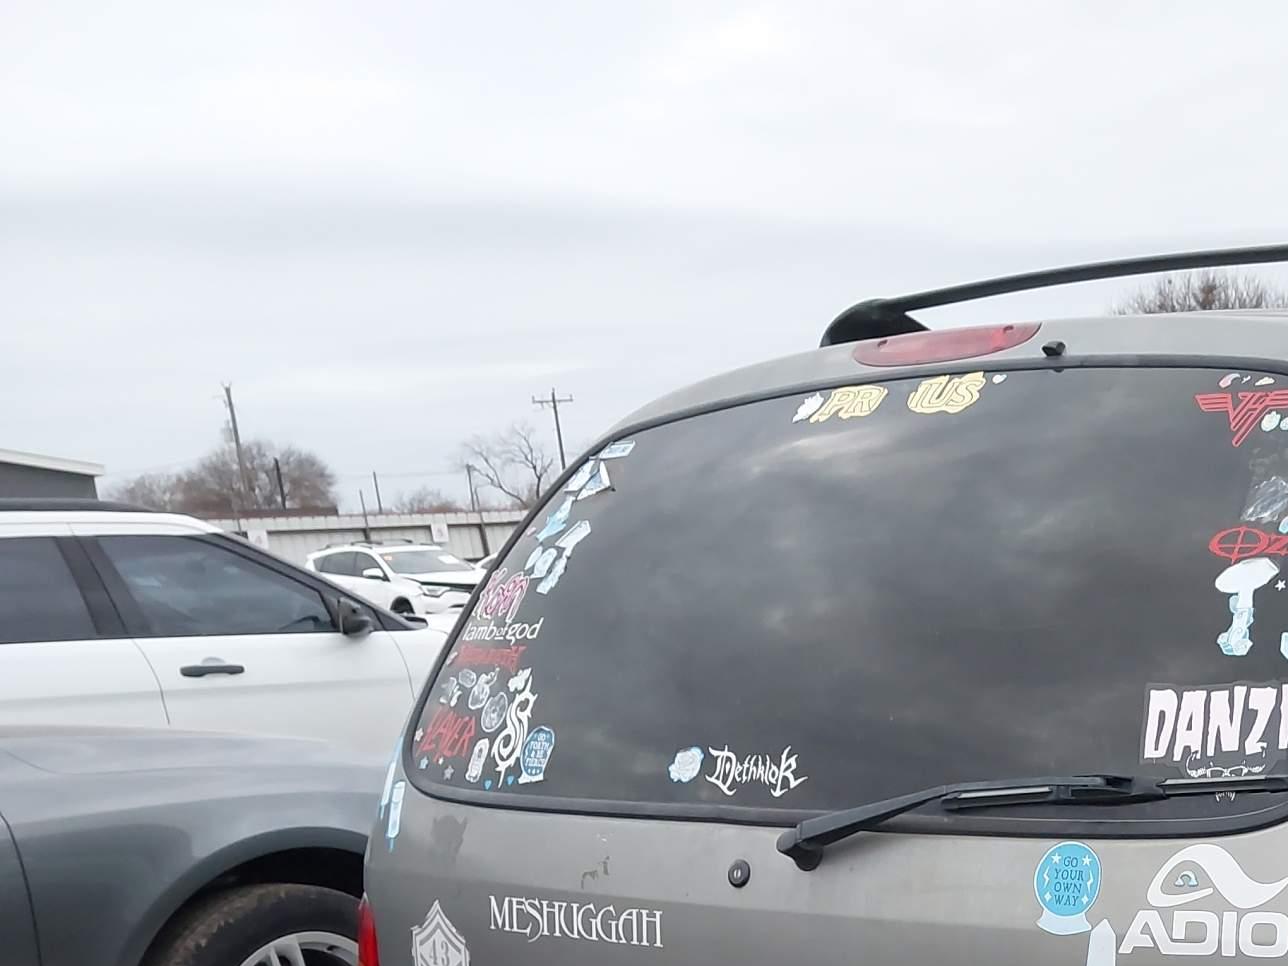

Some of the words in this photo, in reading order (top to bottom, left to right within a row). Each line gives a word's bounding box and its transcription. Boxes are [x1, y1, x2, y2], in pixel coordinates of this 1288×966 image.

[462, 621, 496, 641] lamb
[506, 617, 544, 645] god
[1063, 856, 1079, 868] GO
[1054, 868, 1084, 881] YOUR
[1054, 881, 1082, 893] OWN
[1053, 894, 1080, 907] WAY
[489, 895, 664, 948] MESHUGGAH
